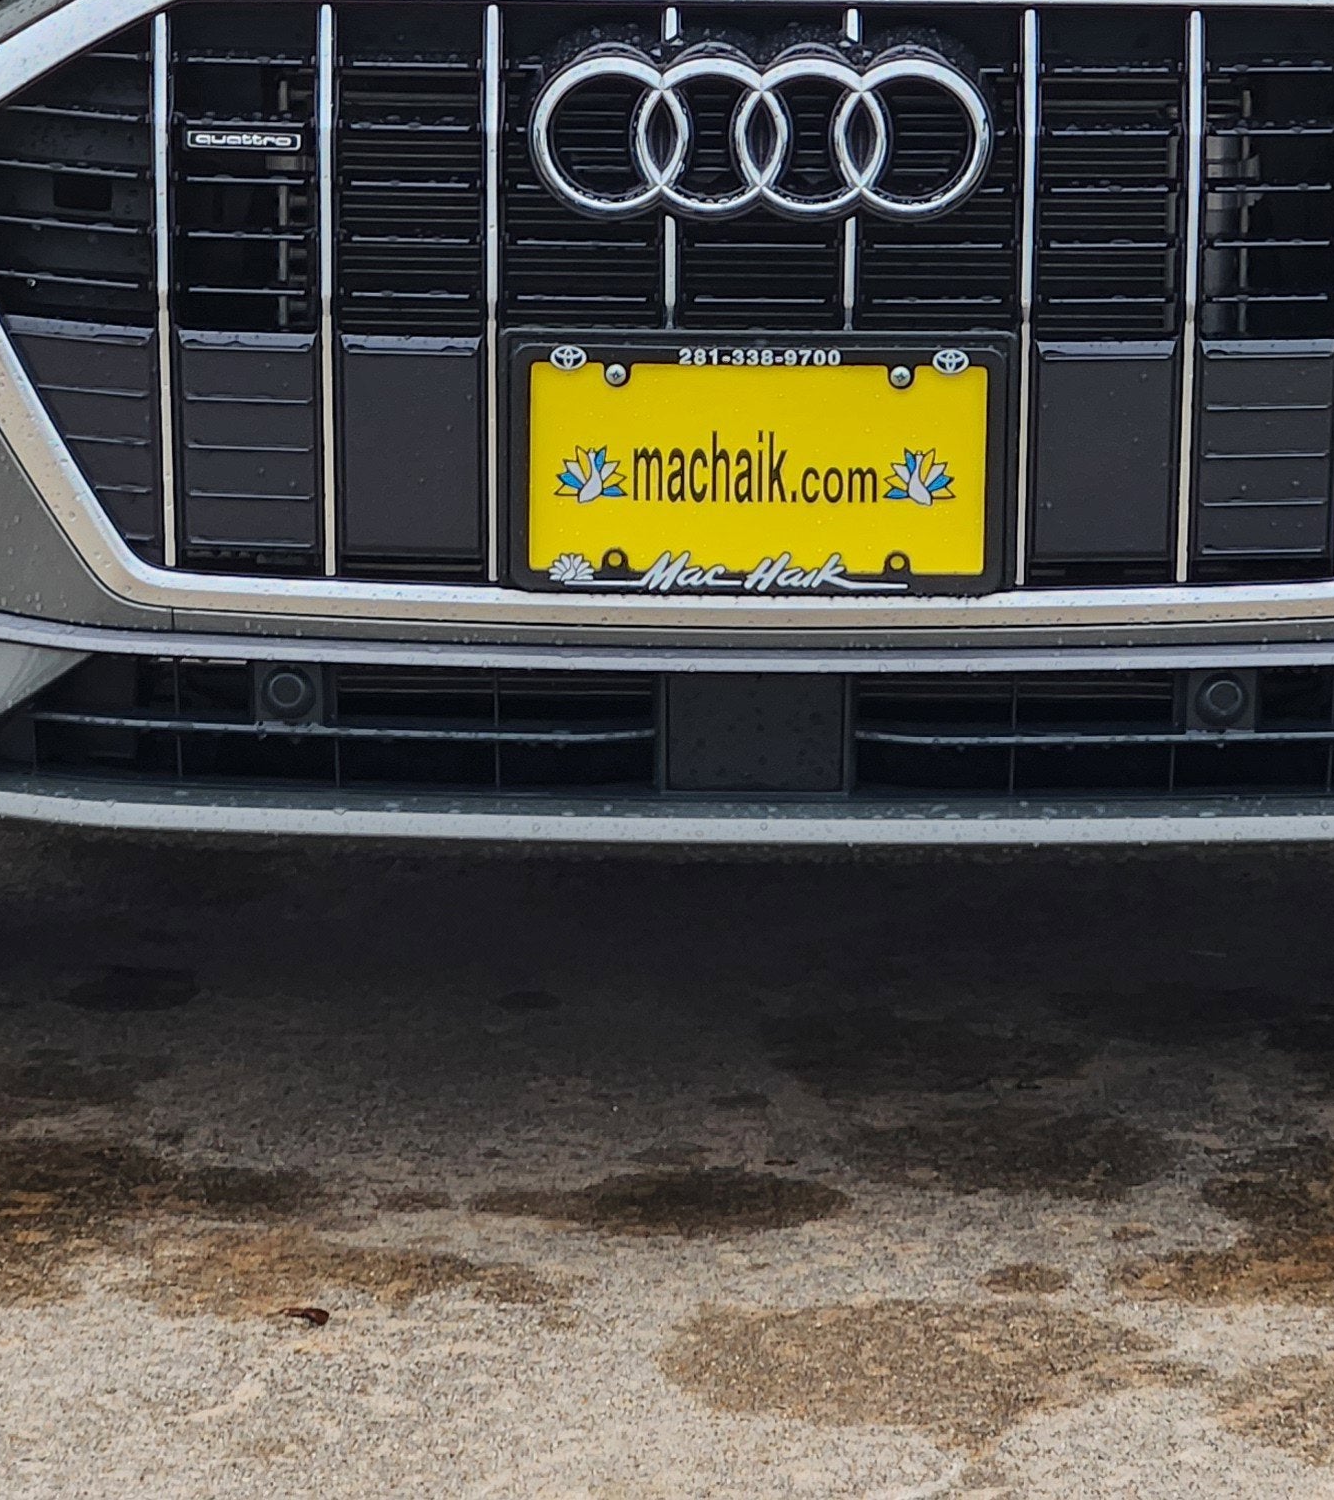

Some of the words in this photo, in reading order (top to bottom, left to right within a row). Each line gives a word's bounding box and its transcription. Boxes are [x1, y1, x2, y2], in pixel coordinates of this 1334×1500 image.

[195, 134, 292, 147] quattro
[678, 348, 842, 367] 281-338-9700
[632, 430, 878, 503] machaik.com
[639, 550, 727, 591] Mac
[744, 551, 847, 591] Haik
